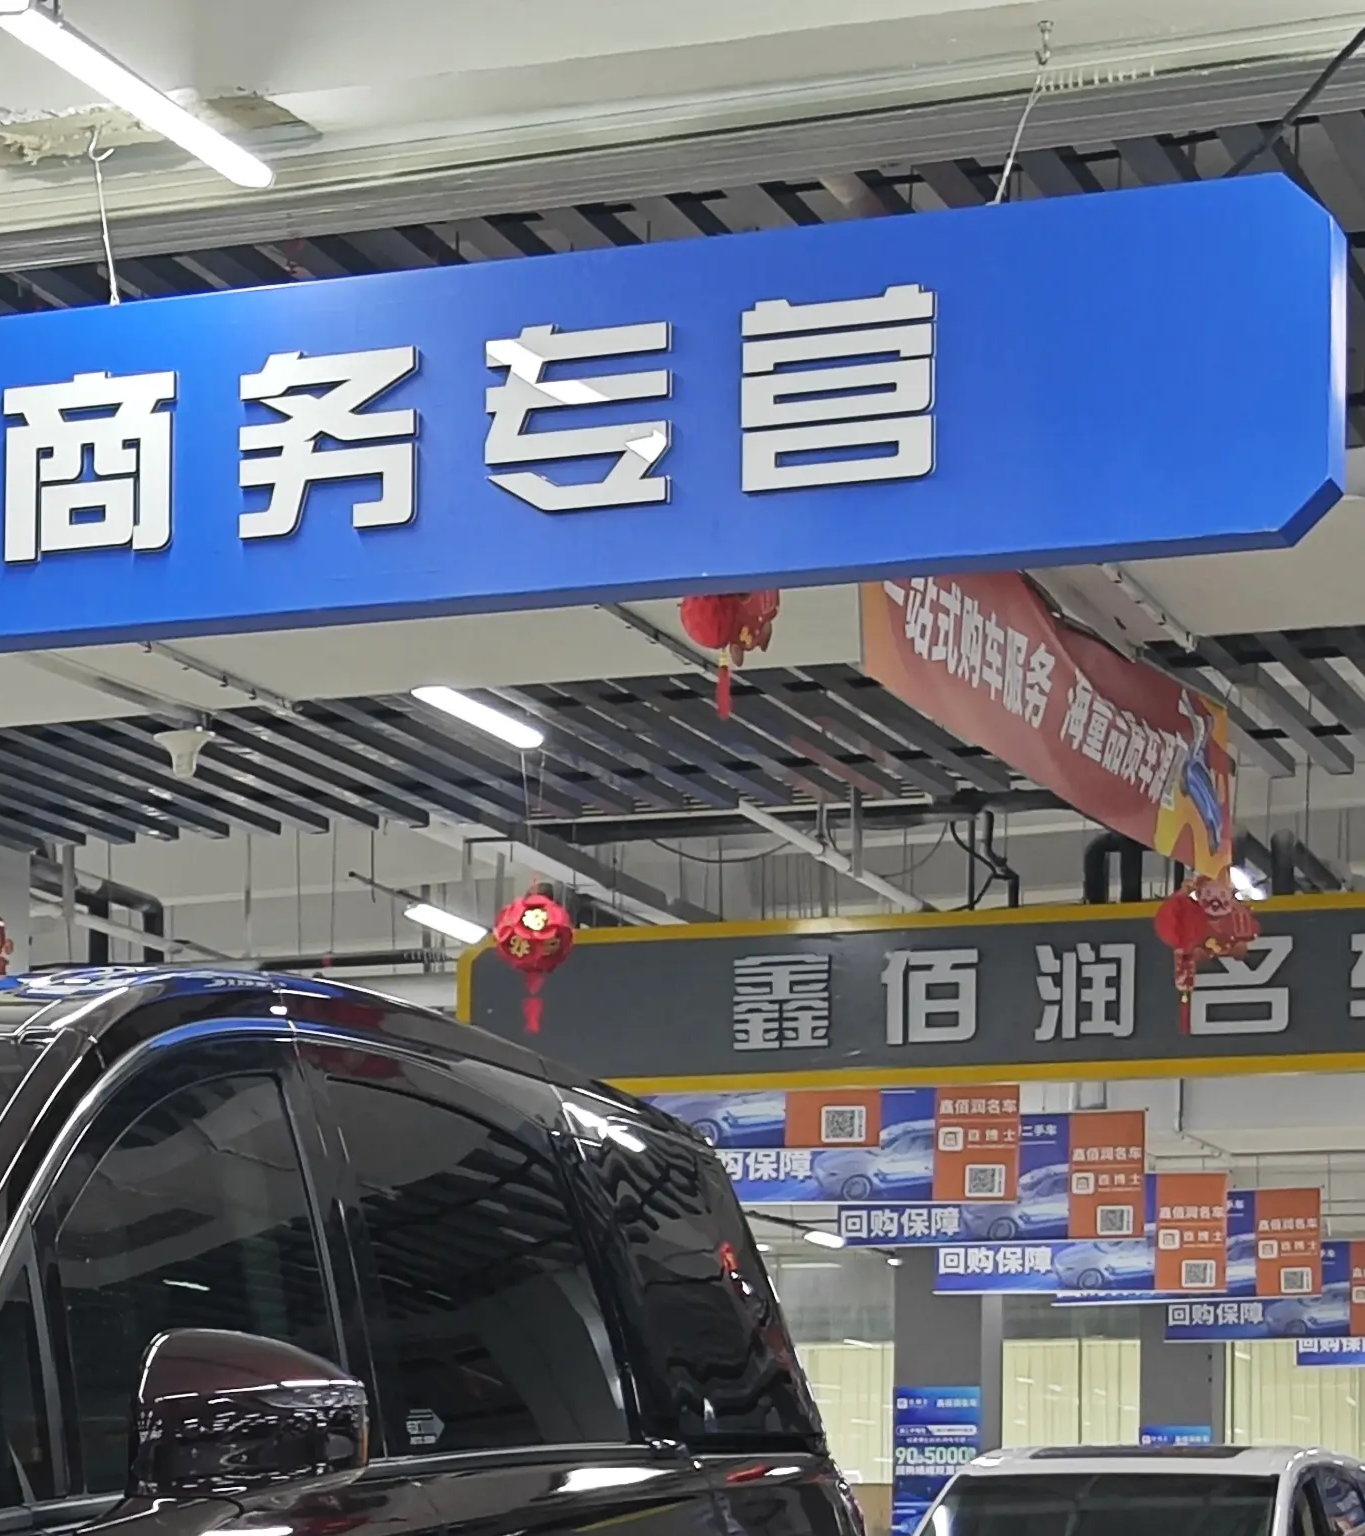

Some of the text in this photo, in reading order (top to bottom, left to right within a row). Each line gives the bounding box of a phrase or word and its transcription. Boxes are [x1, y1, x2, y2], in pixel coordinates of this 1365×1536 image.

[2, 284, 937, 564] 商务专营
[883, 576, 1056, 729] 一站式购车服务
[732, 933, 1365, 1051] 鑫佰润名
[1019, 1124, 1057, 1137] 二手车
[840, 1206, 962, 1239] 回购保障
[938, 1246, 1053, 1275] 回购保障
[1168, 1302, 1264, 1326] 回购保障
[1299, 1337, 1365, 1353] 回购保
